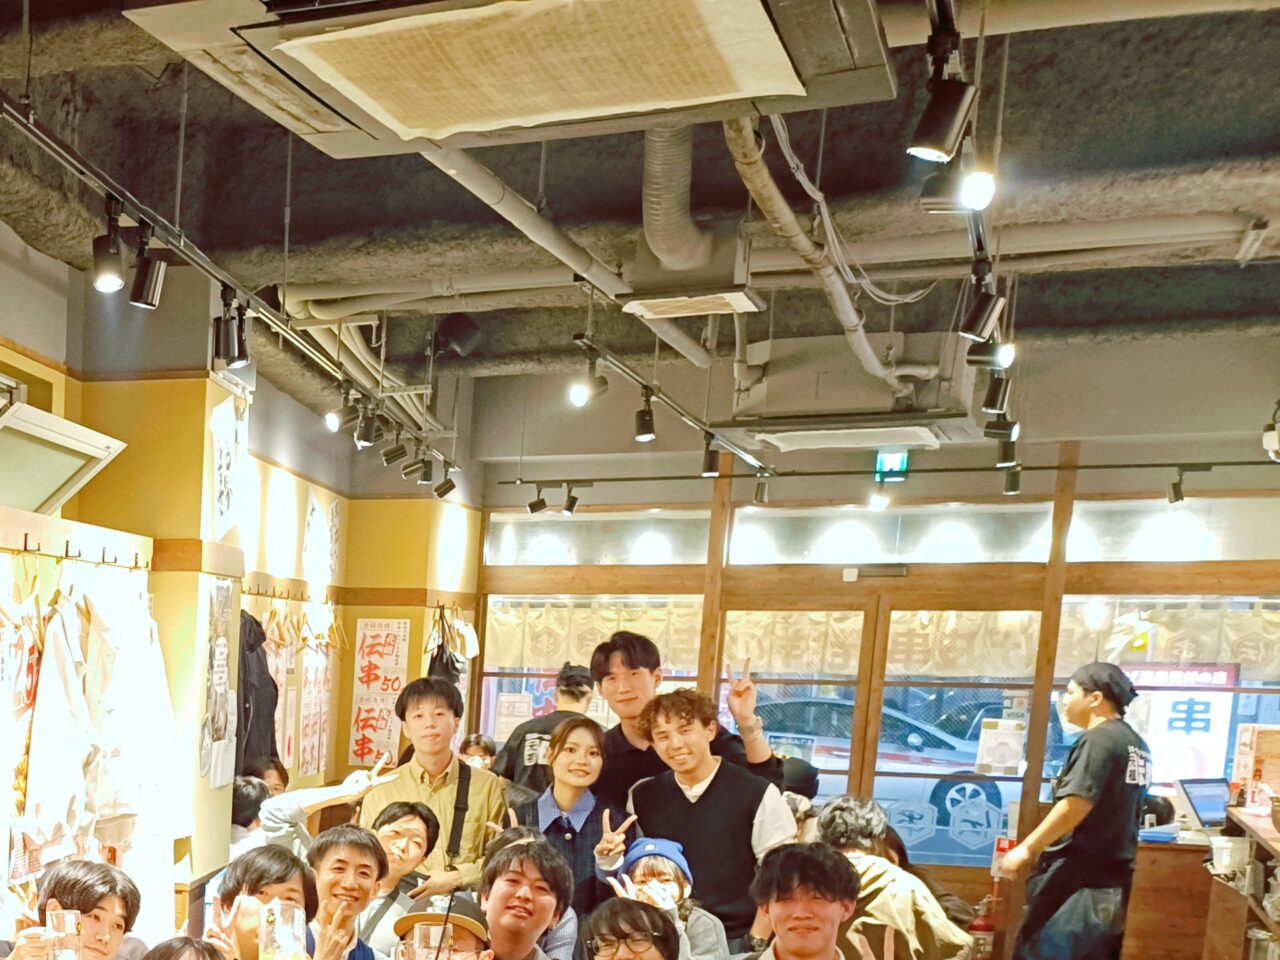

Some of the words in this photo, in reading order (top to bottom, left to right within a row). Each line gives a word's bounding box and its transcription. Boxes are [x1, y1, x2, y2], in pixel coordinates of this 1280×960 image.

[357, 632, 385, 691] 伝串
[381, 675, 401, 692] 50
[352, 706, 378, 764] 伝串
[1167, 697, 1211, 735] 串
